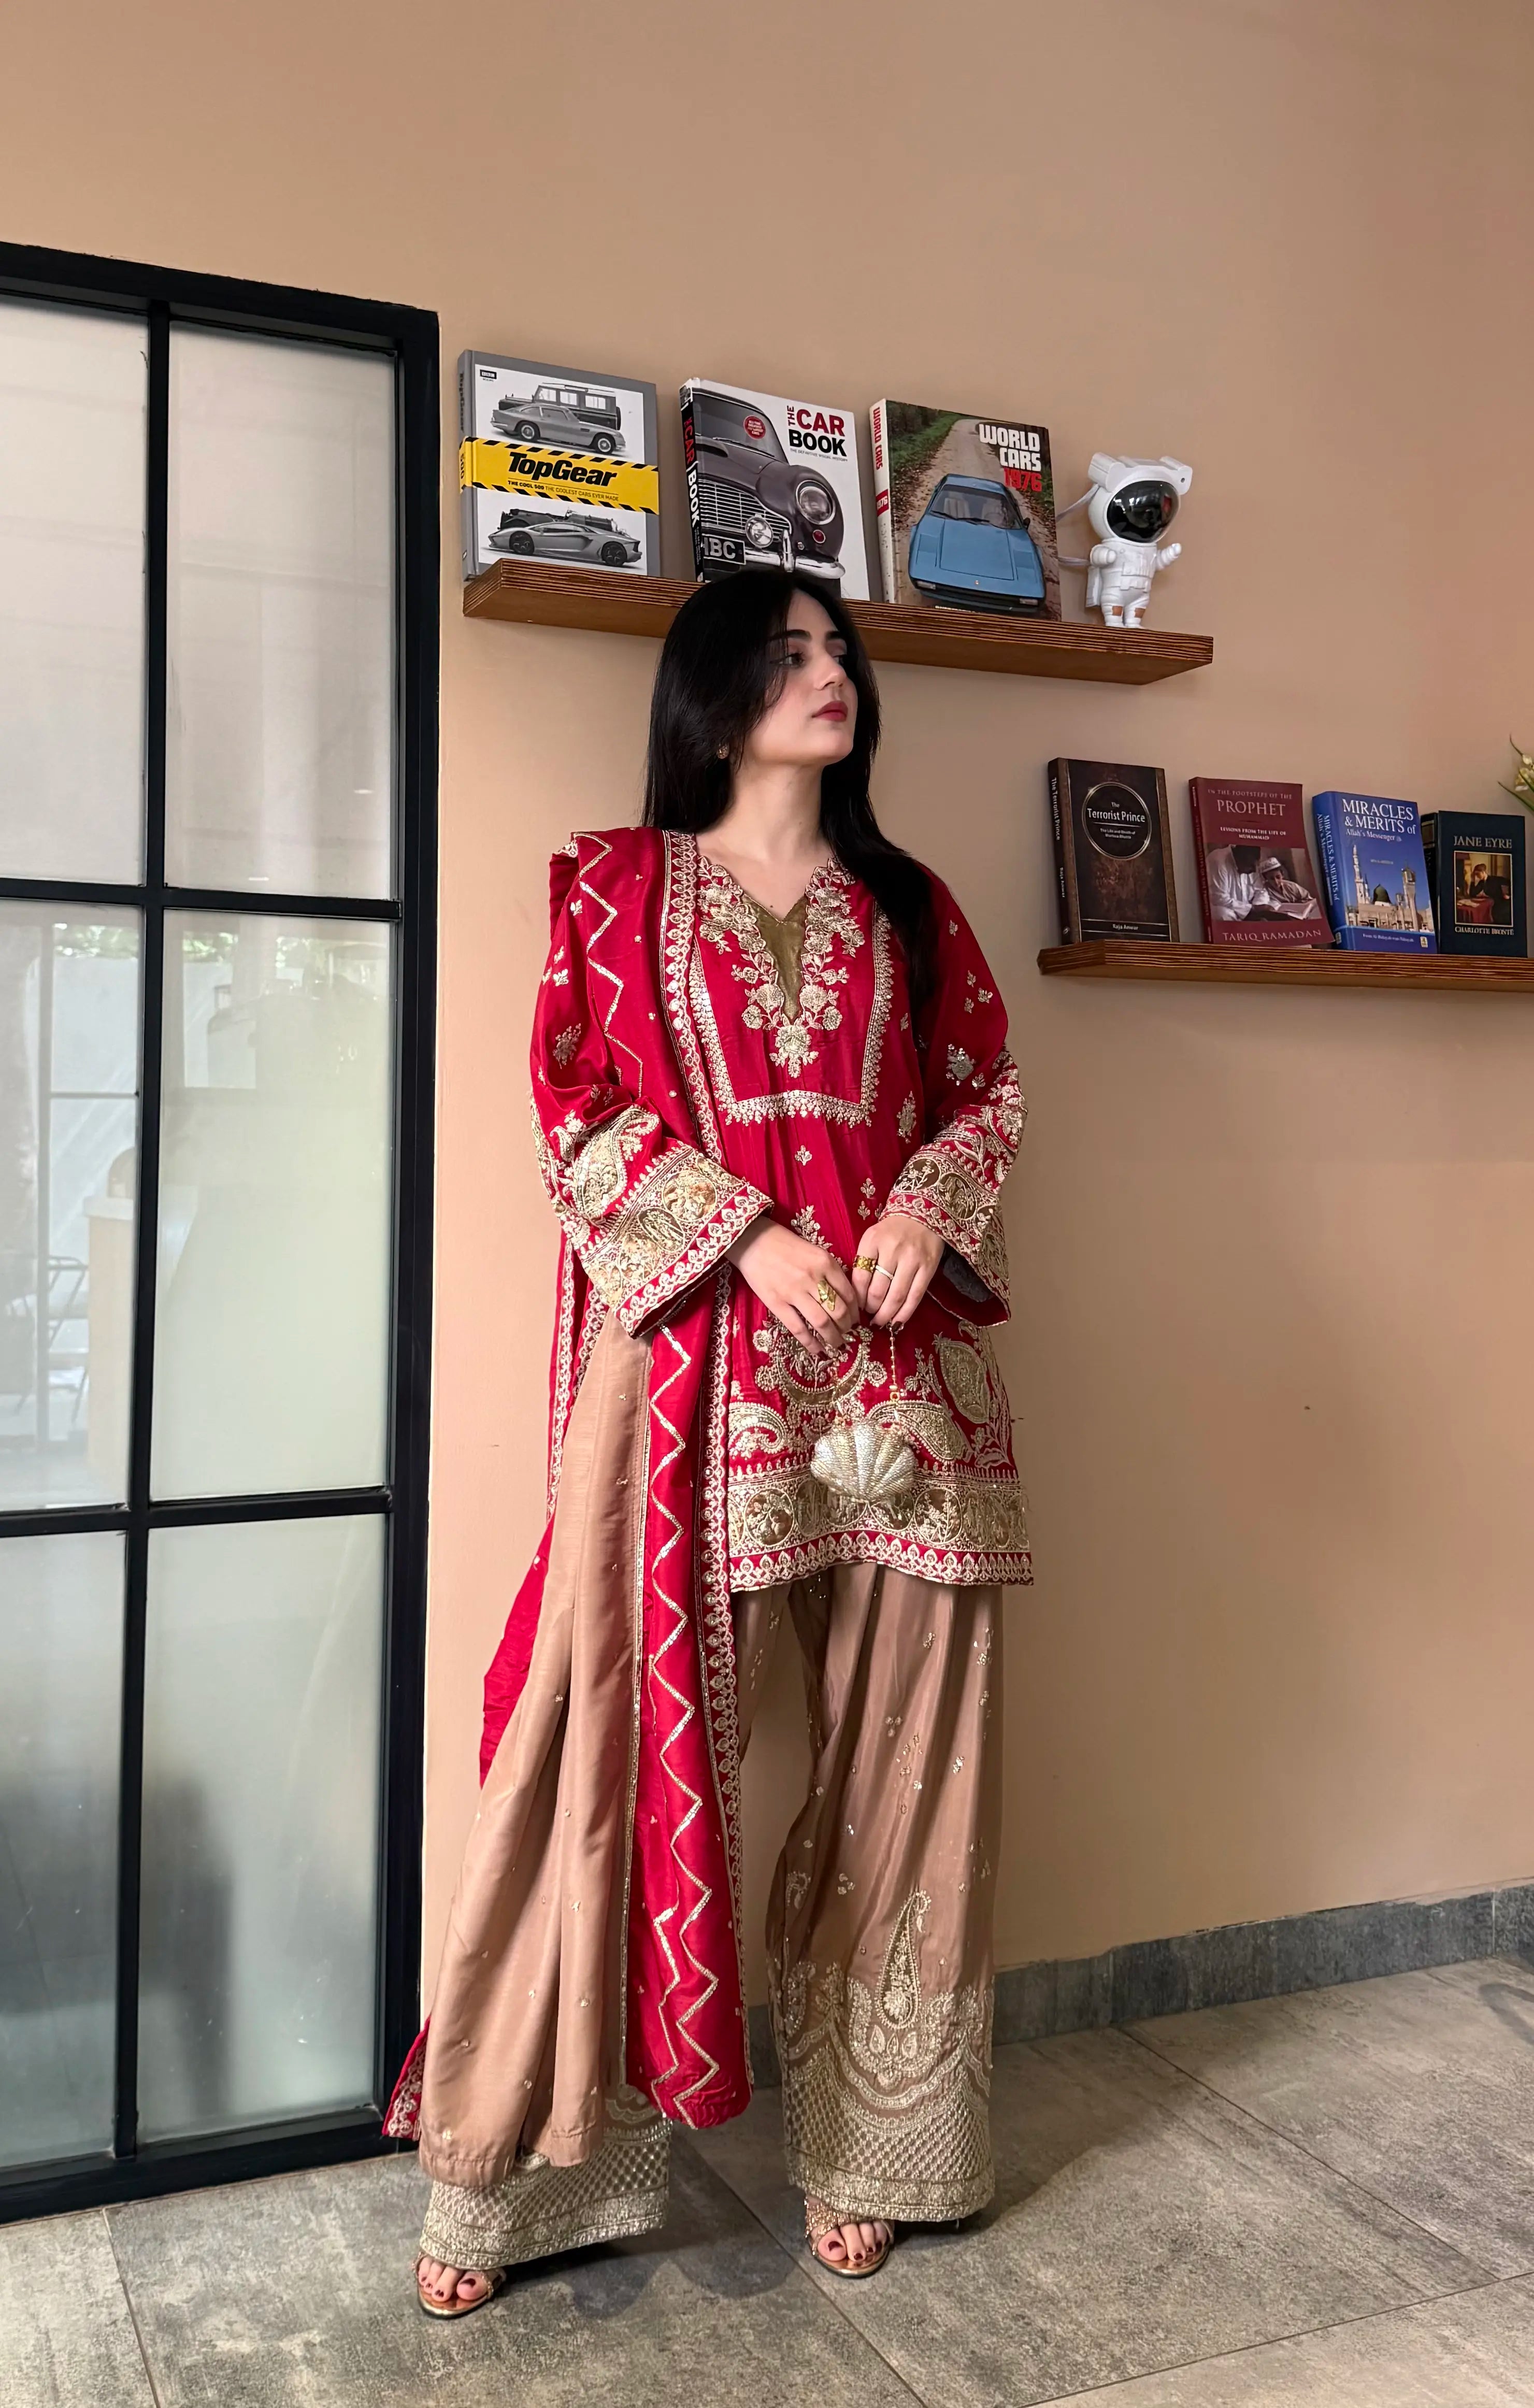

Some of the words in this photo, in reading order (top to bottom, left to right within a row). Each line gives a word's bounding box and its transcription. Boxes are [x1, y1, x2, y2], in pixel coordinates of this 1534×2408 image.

[787, 405, 795, 426] THE
[796, 409, 845, 437] CAR
[873, 407, 881, 443] WORLD
[685, 425, 695, 465] CAR
[788, 429, 847, 456] BOOK
[979, 424, 1040, 452] WORLD
[508, 451, 618, 486] TopGear
[999, 448, 1041, 471] CARS
[1003, 467, 1042, 492] 1976
[688, 469, 699, 528] BOOK
[1087, 808, 1120, 820] Terrorist
[1121, 811, 1145, 822] Prince
[1217, 799, 1286, 816] PROPHET
[1342, 798, 1413, 821] MIRACLES
[1324, 815, 1334, 855] MIRACLES
[1344, 816, 1353, 826] &
[1355, 814, 1404, 833] MERITS
[1407, 824, 1416, 834] of
[1367, 830, 1395, 841] Messenger
[1454, 836, 1482, 847] JANE
[1485, 838, 1512, 849] EYRE
[1223, 933, 1263, 942] TARIQ
[1263, 929, 1321, 940] RAMADAN
